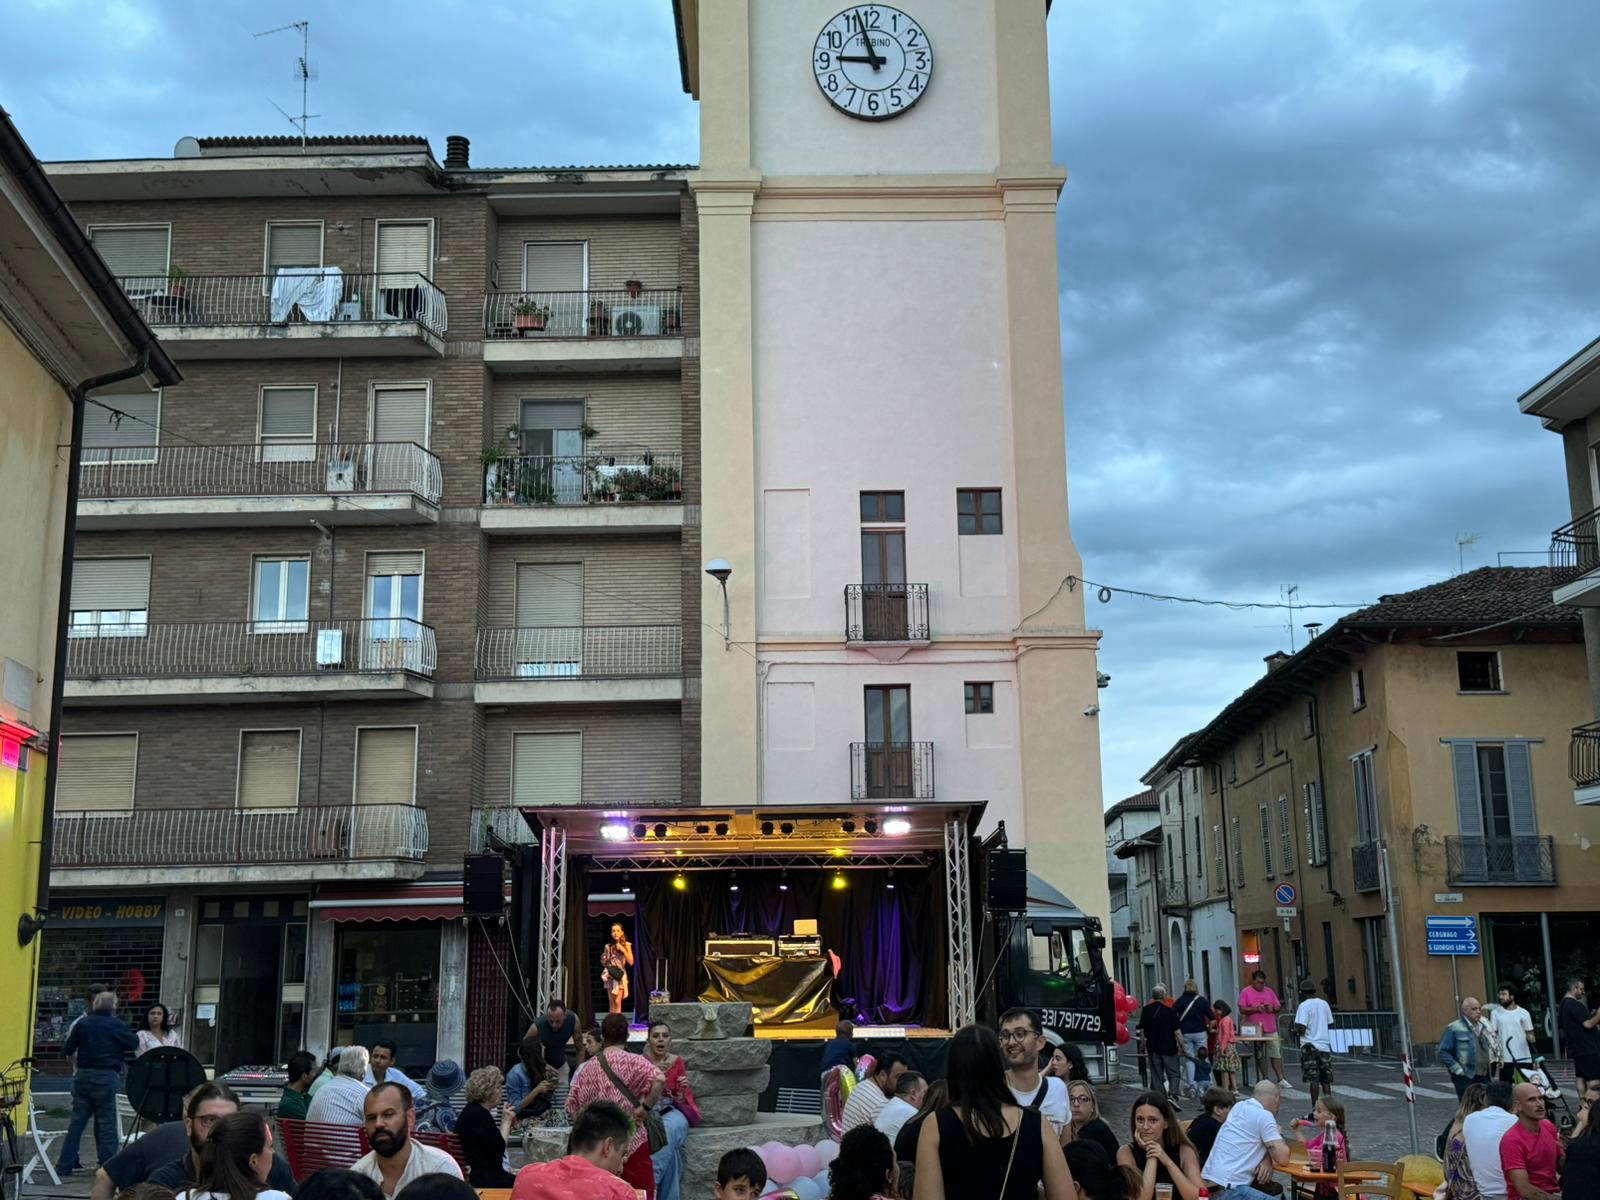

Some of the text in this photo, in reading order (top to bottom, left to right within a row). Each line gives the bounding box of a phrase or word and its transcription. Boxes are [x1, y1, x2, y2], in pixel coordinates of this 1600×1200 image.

[845, 15, 857, 33] 11
[864, 10, 880, 29] 12
[892, 14, 897, 32] 1
[827, 31, 842, 49] 10
[856, 38, 890, 48] TRBINO
[907, 29, 919, 47] 2
[819, 52, 830, 70] 9
[915, 52, 926, 70] 3
[827, 74, 838, 92] 8
[908, 74, 919, 92] 4
[846, 88, 857, 106] 7
[868, 93, 879, 111] 6
[890, 88, 901, 107] 5
[62, 906, 102, 920] VIDEO
[116, 905, 161, 919] HOBBY
[1041, 1008, 1101, 1032] 331 7917729
